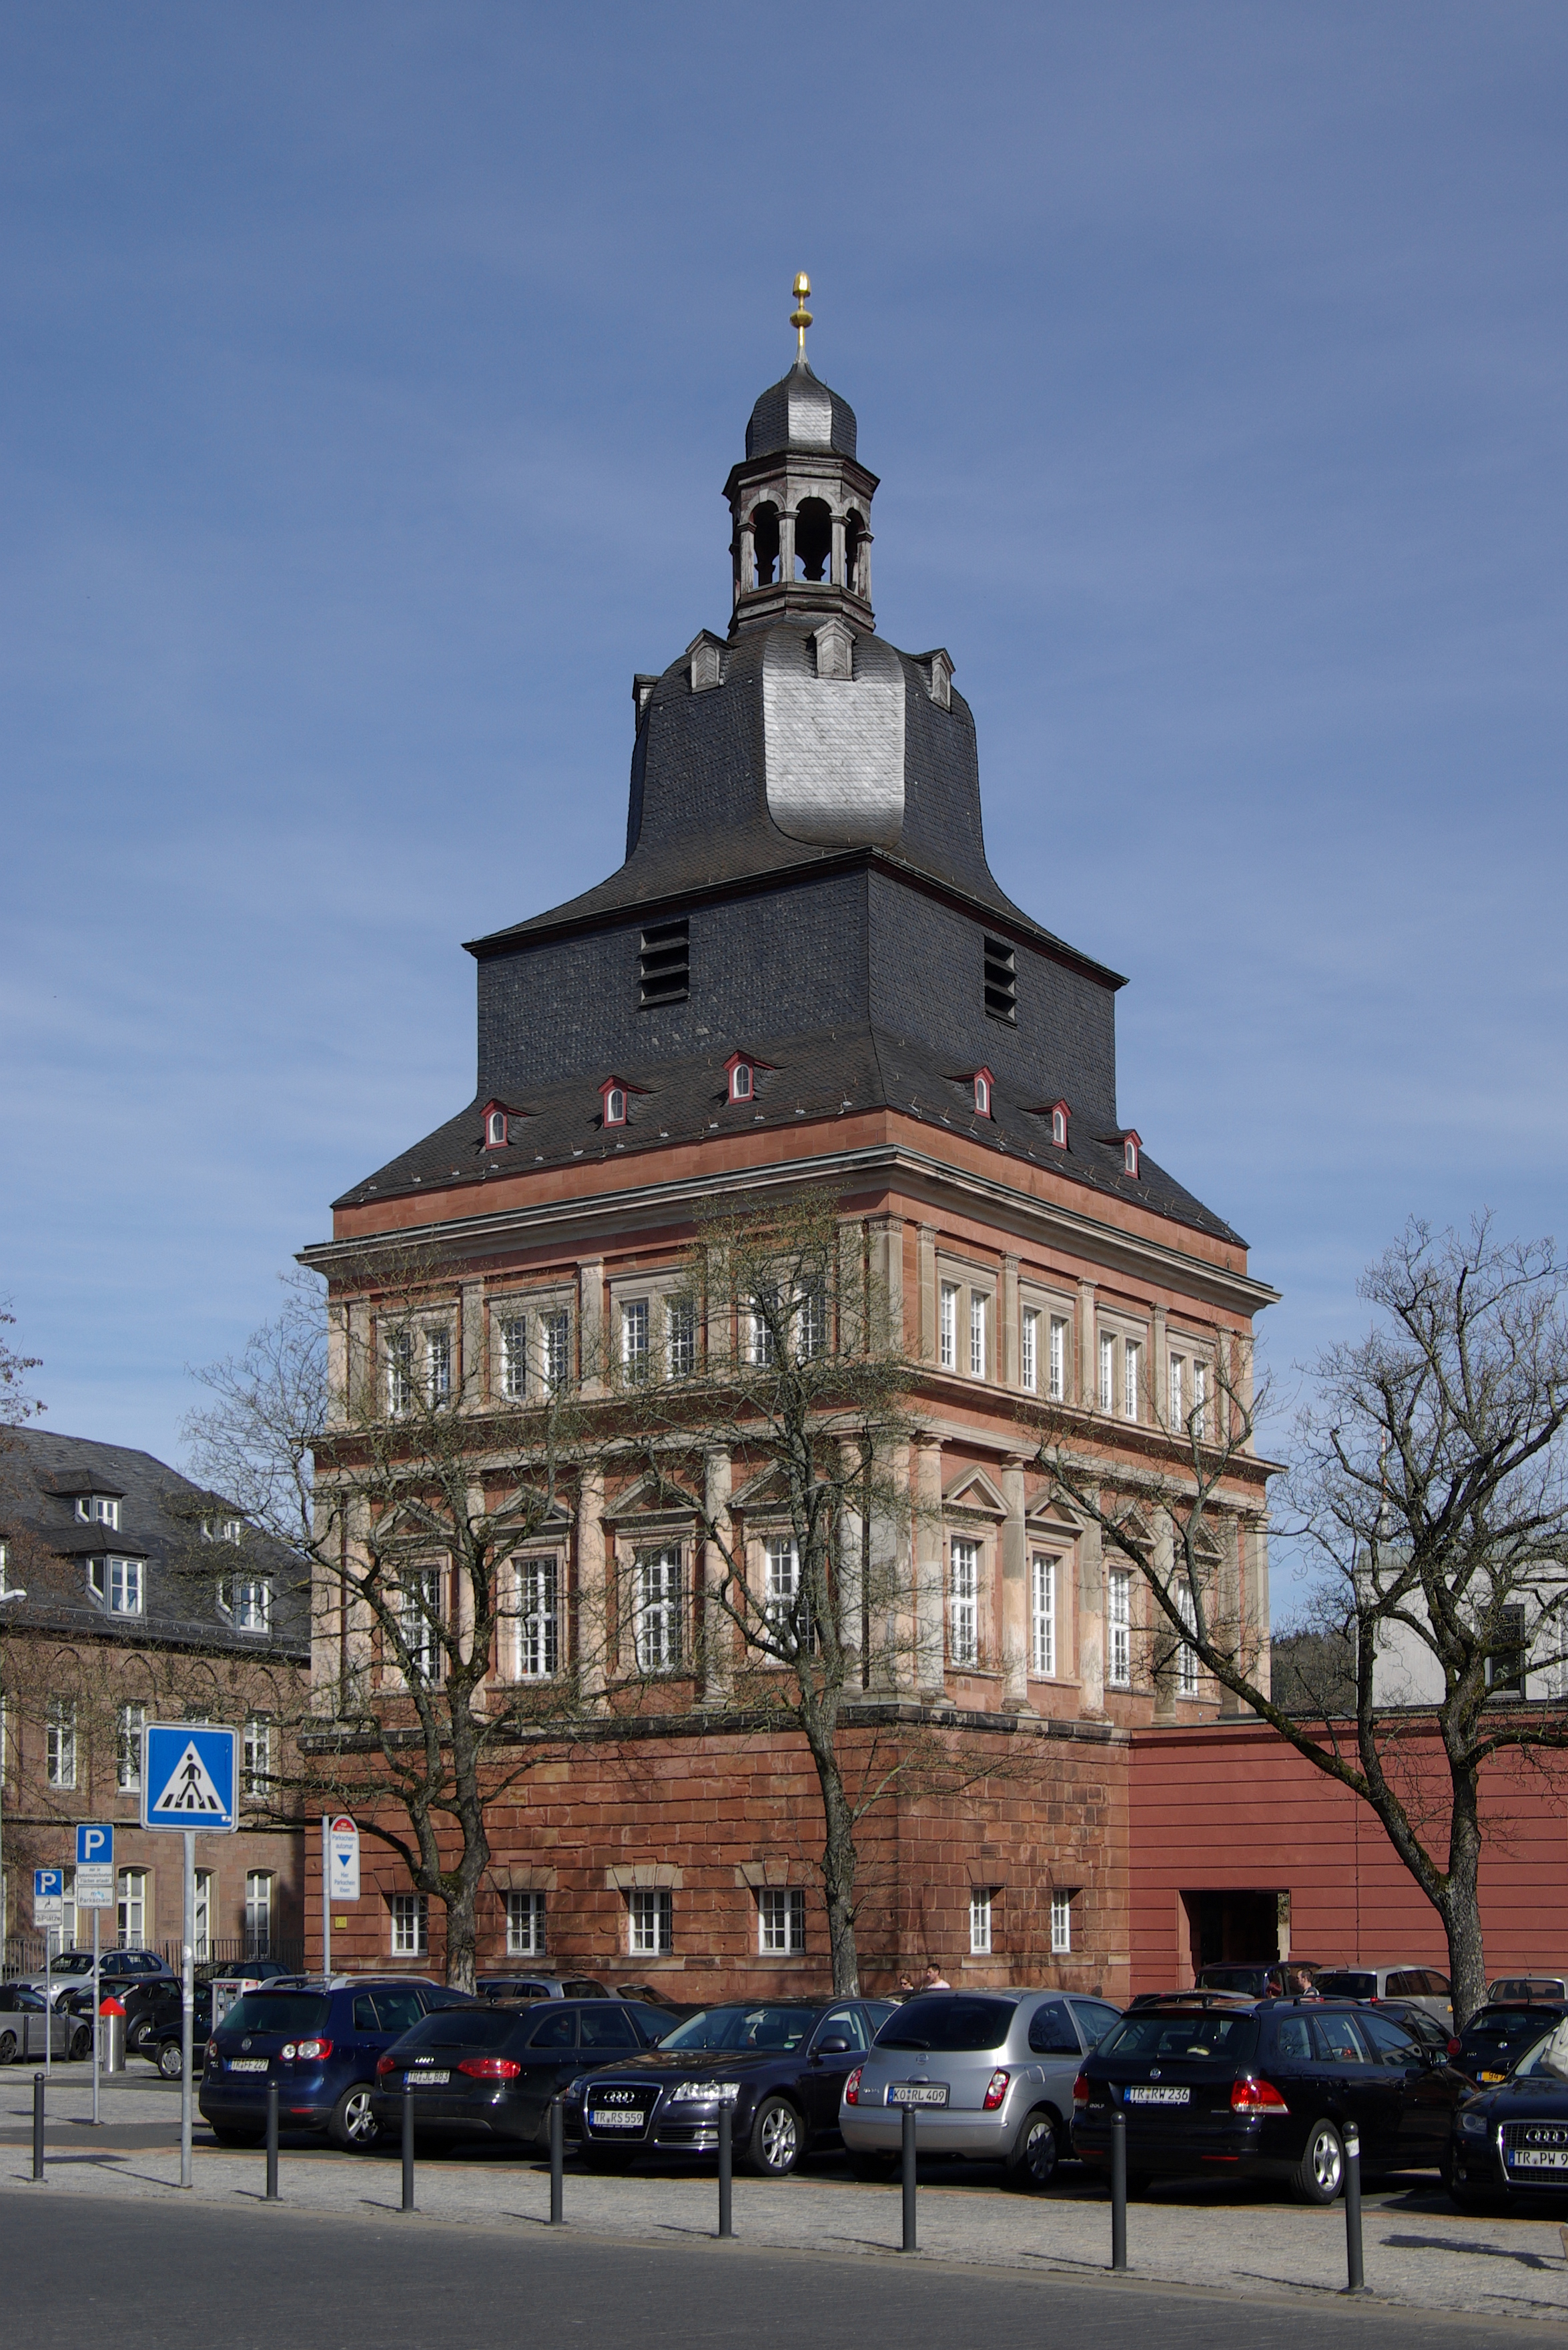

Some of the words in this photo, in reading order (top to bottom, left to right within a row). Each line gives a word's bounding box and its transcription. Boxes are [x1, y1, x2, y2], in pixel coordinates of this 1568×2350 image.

[85, 1830, 105, 1859] P
[41, 1872, 56, 1894] P
[894, 2089, 905, 2100] KO
[911, 2089, 923, 2100] RL
[926, 2090, 944, 2101] 409
[1132, 2086, 1144, 2099] TR
[1152, 2087, 1165, 2100] RW
[1168, 2088, 1188, 2100] 236
[595, 2112, 606, 2122] TR
[611, 2112, 623, 2123] RS
[625, 2112, 643, 2124] 559
[1515, 2151, 1530, 2164] TR
[1539, 2152, 1555, 2165] PW
